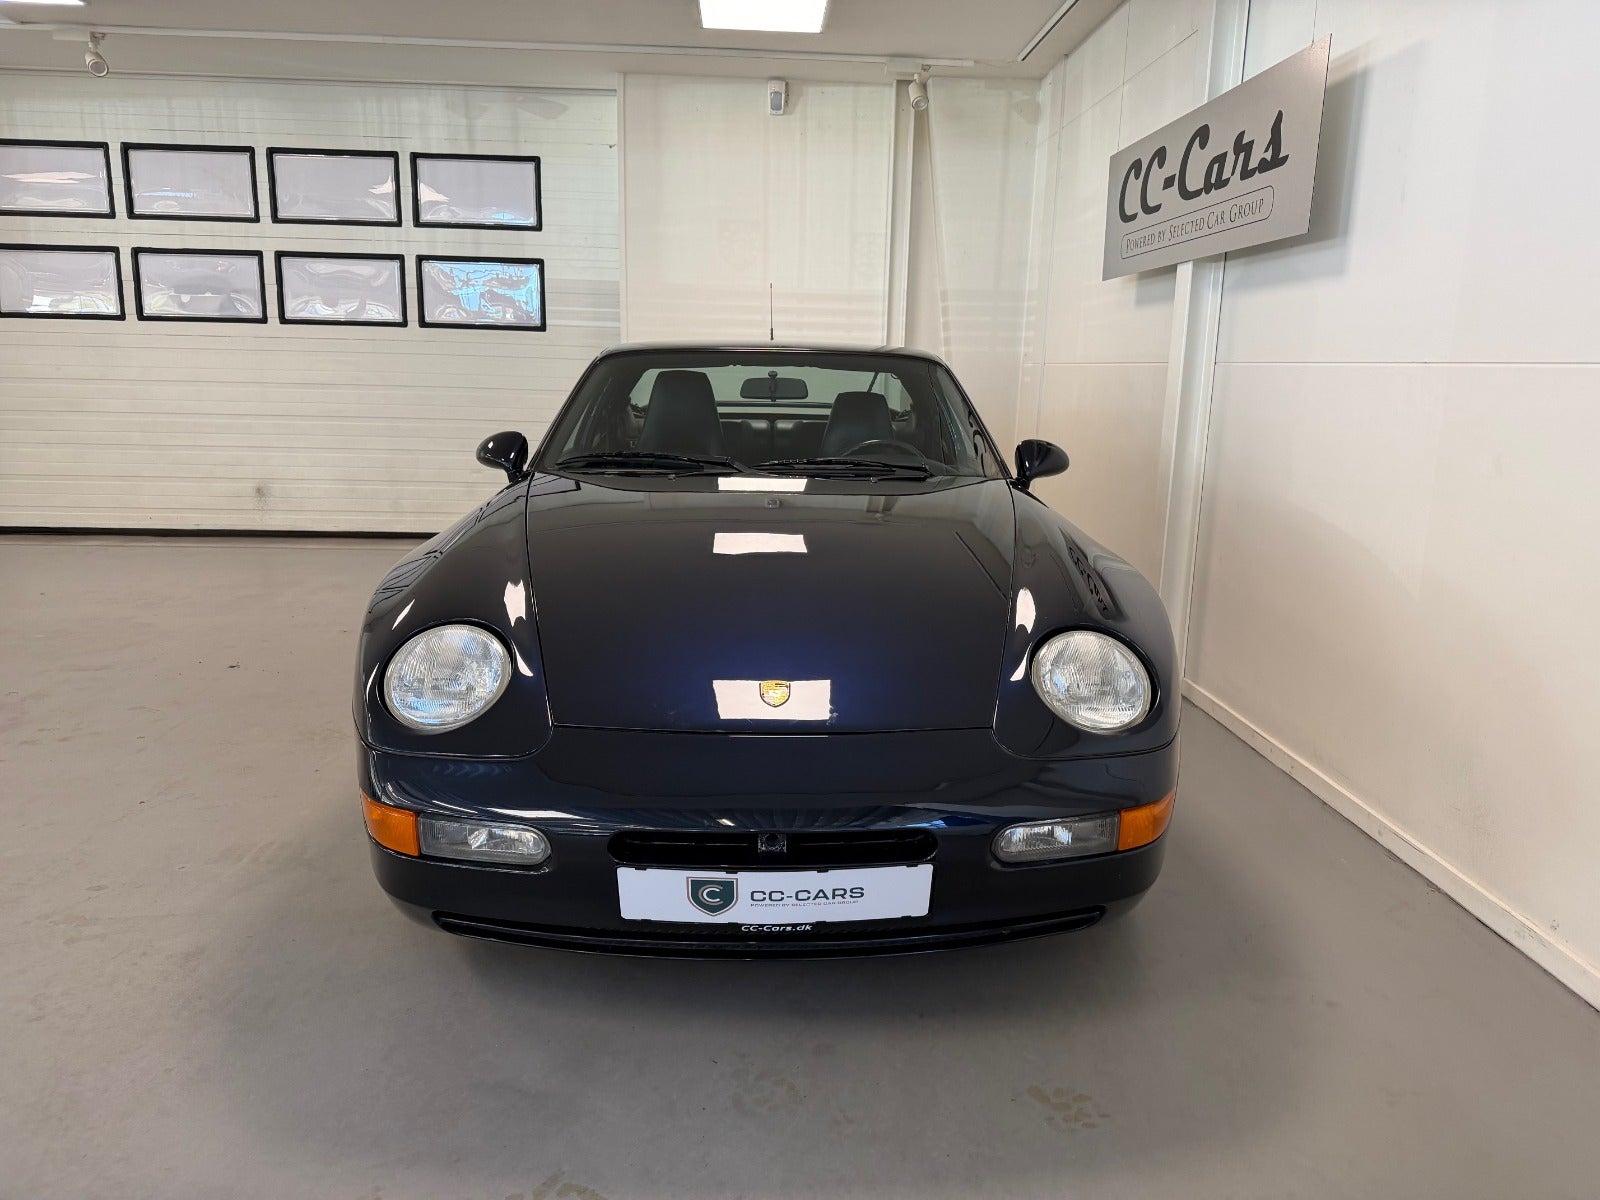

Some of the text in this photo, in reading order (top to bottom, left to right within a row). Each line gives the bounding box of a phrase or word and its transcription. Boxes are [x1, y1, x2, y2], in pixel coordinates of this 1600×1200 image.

[1118, 109, 1290, 224] CC-Cars
[1125, 198, 1265, 254] POWERED BY SELECTED CAR GROUP
[750, 886, 865, 902] CC-CARS
[741, 924, 813, 932] CC-Cars.dk
